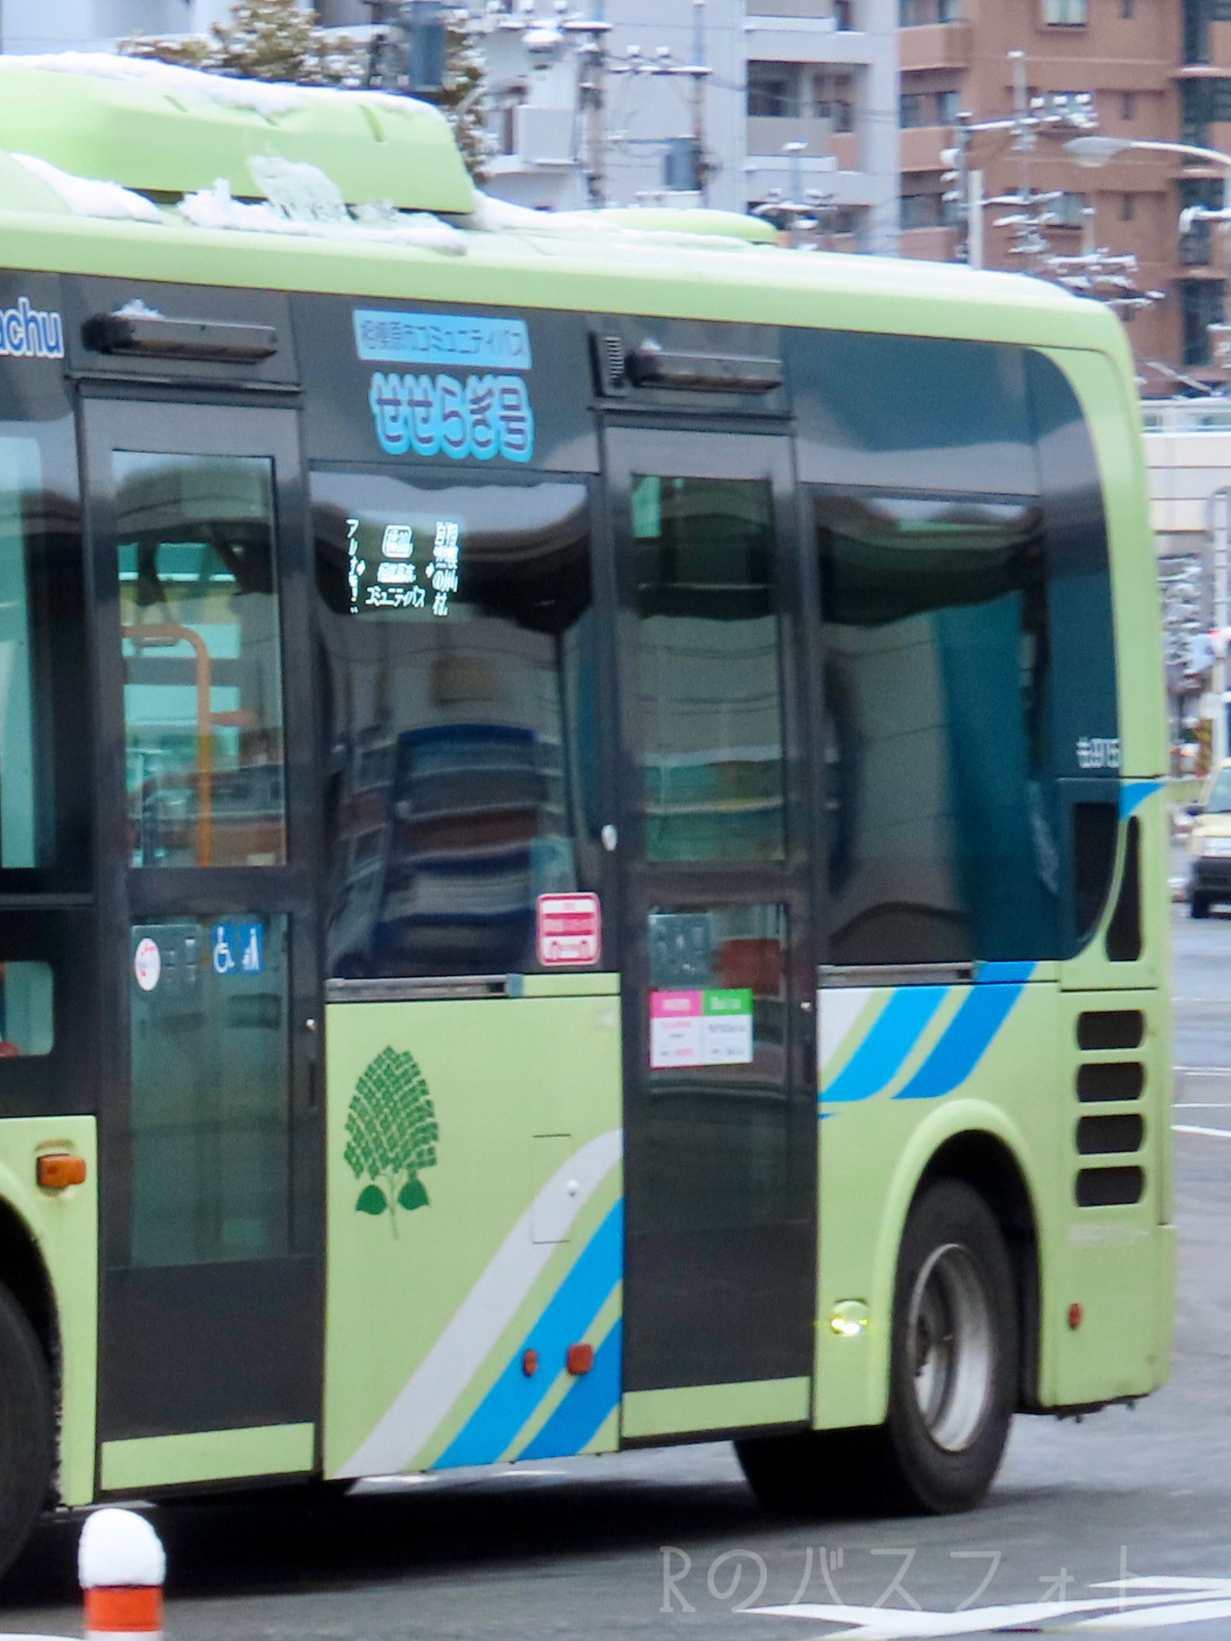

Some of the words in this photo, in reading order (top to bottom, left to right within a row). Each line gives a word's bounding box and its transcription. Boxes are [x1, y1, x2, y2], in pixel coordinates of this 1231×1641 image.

[375, 383, 527, 451] せせらぎ号
